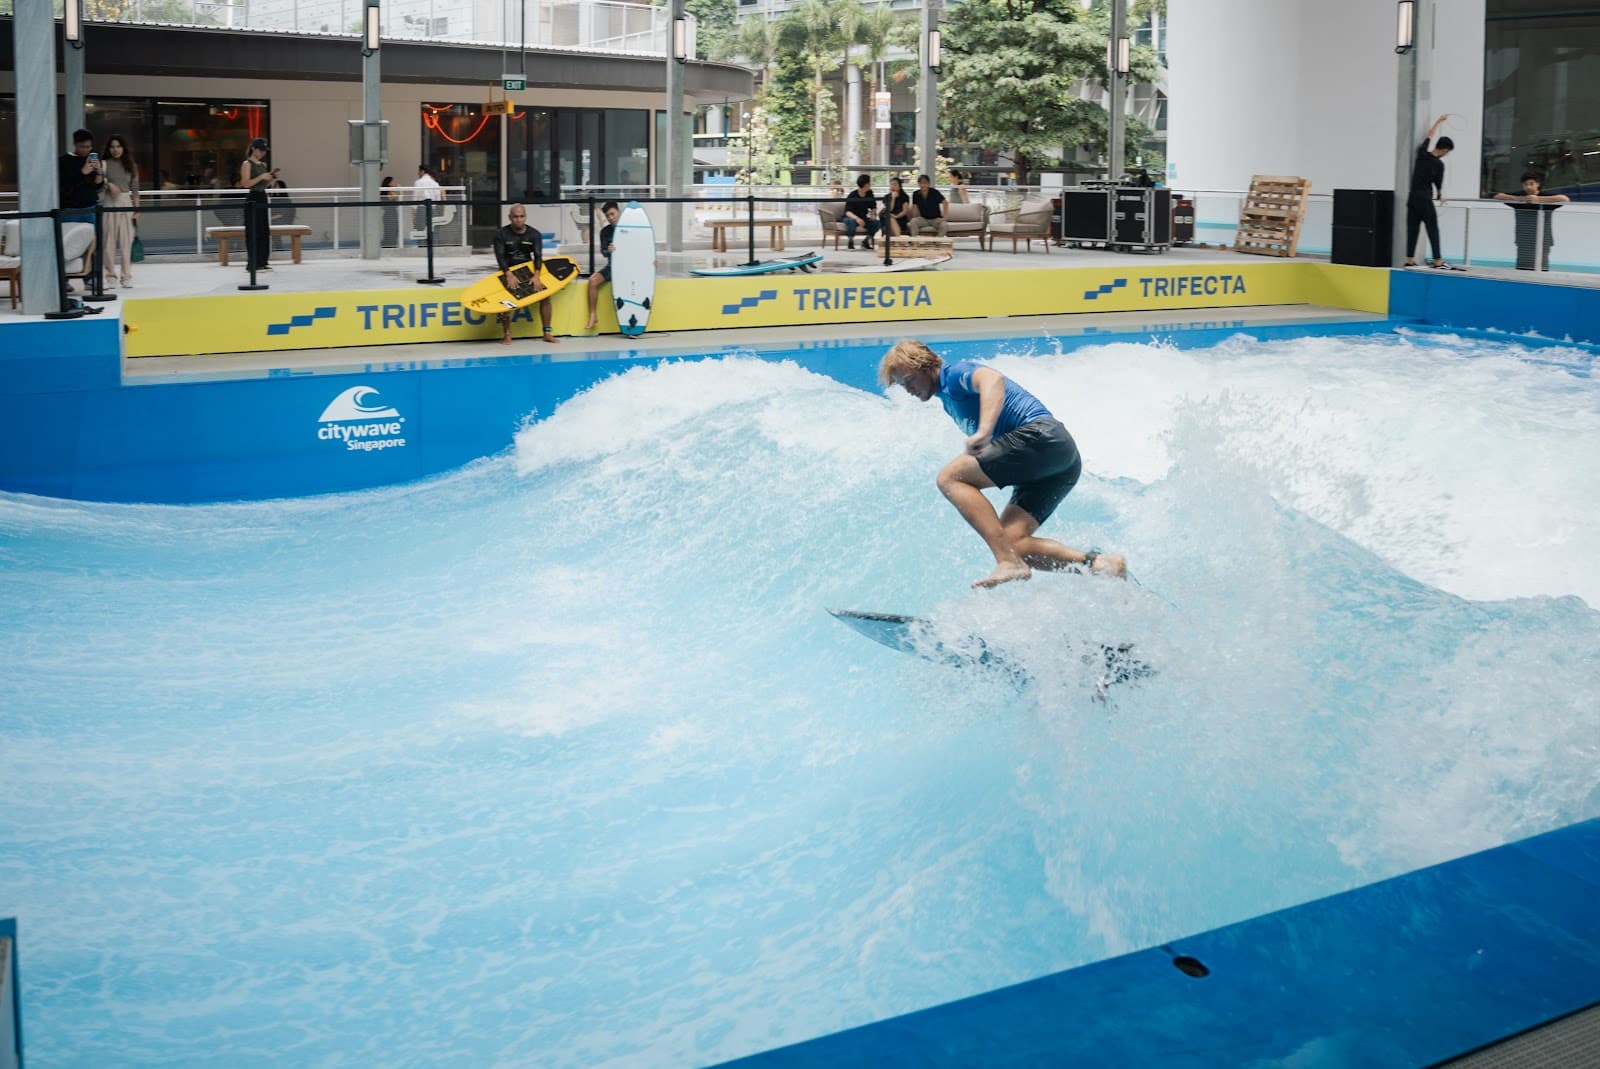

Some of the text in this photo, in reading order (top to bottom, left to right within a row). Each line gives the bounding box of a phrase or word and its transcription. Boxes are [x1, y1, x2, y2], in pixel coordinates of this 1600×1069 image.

[506, 81, 522, 90] EXIT
[1139, 275, 1247, 298] TRIFECTA
[793, 285, 932, 311] TRIFECTA
[317, 422, 401, 441] citywave
[346, 439, 406, 451] Singapore
